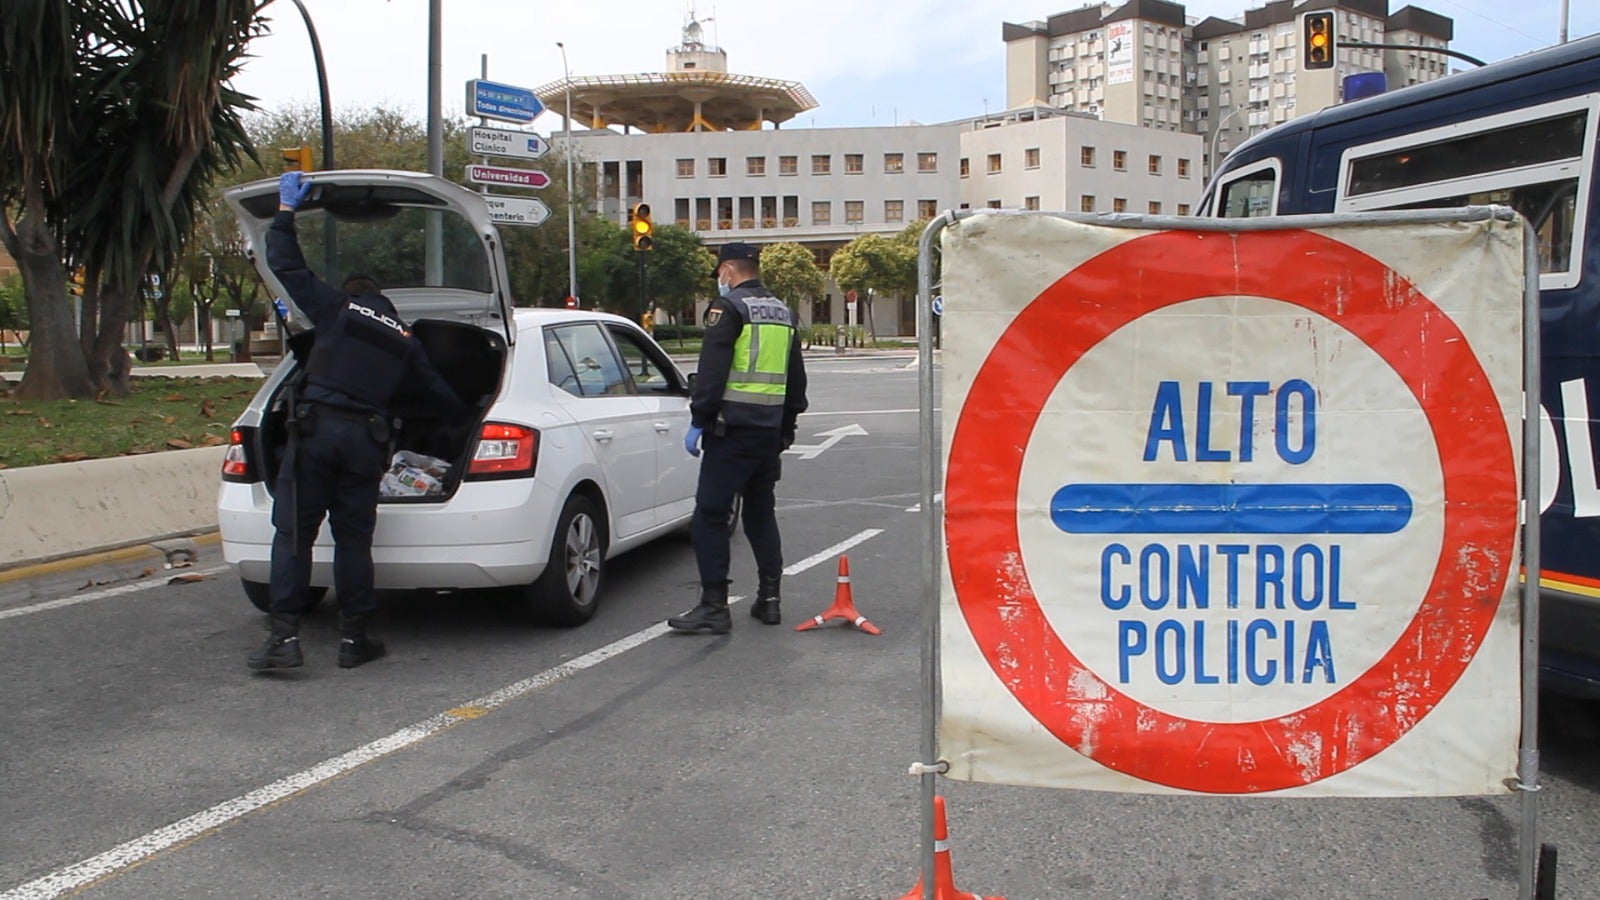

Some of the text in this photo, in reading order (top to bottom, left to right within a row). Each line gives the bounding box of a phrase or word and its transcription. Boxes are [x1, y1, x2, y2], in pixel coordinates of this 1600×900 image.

[474, 130, 512, 142] Hospital
[473, 169, 530, 183] Universidad
[1142, 378, 1317, 465] ALTO
[1099, 542, 1357, 611] CONTROL
[1117, 618, 1337, 687] POLICIA
